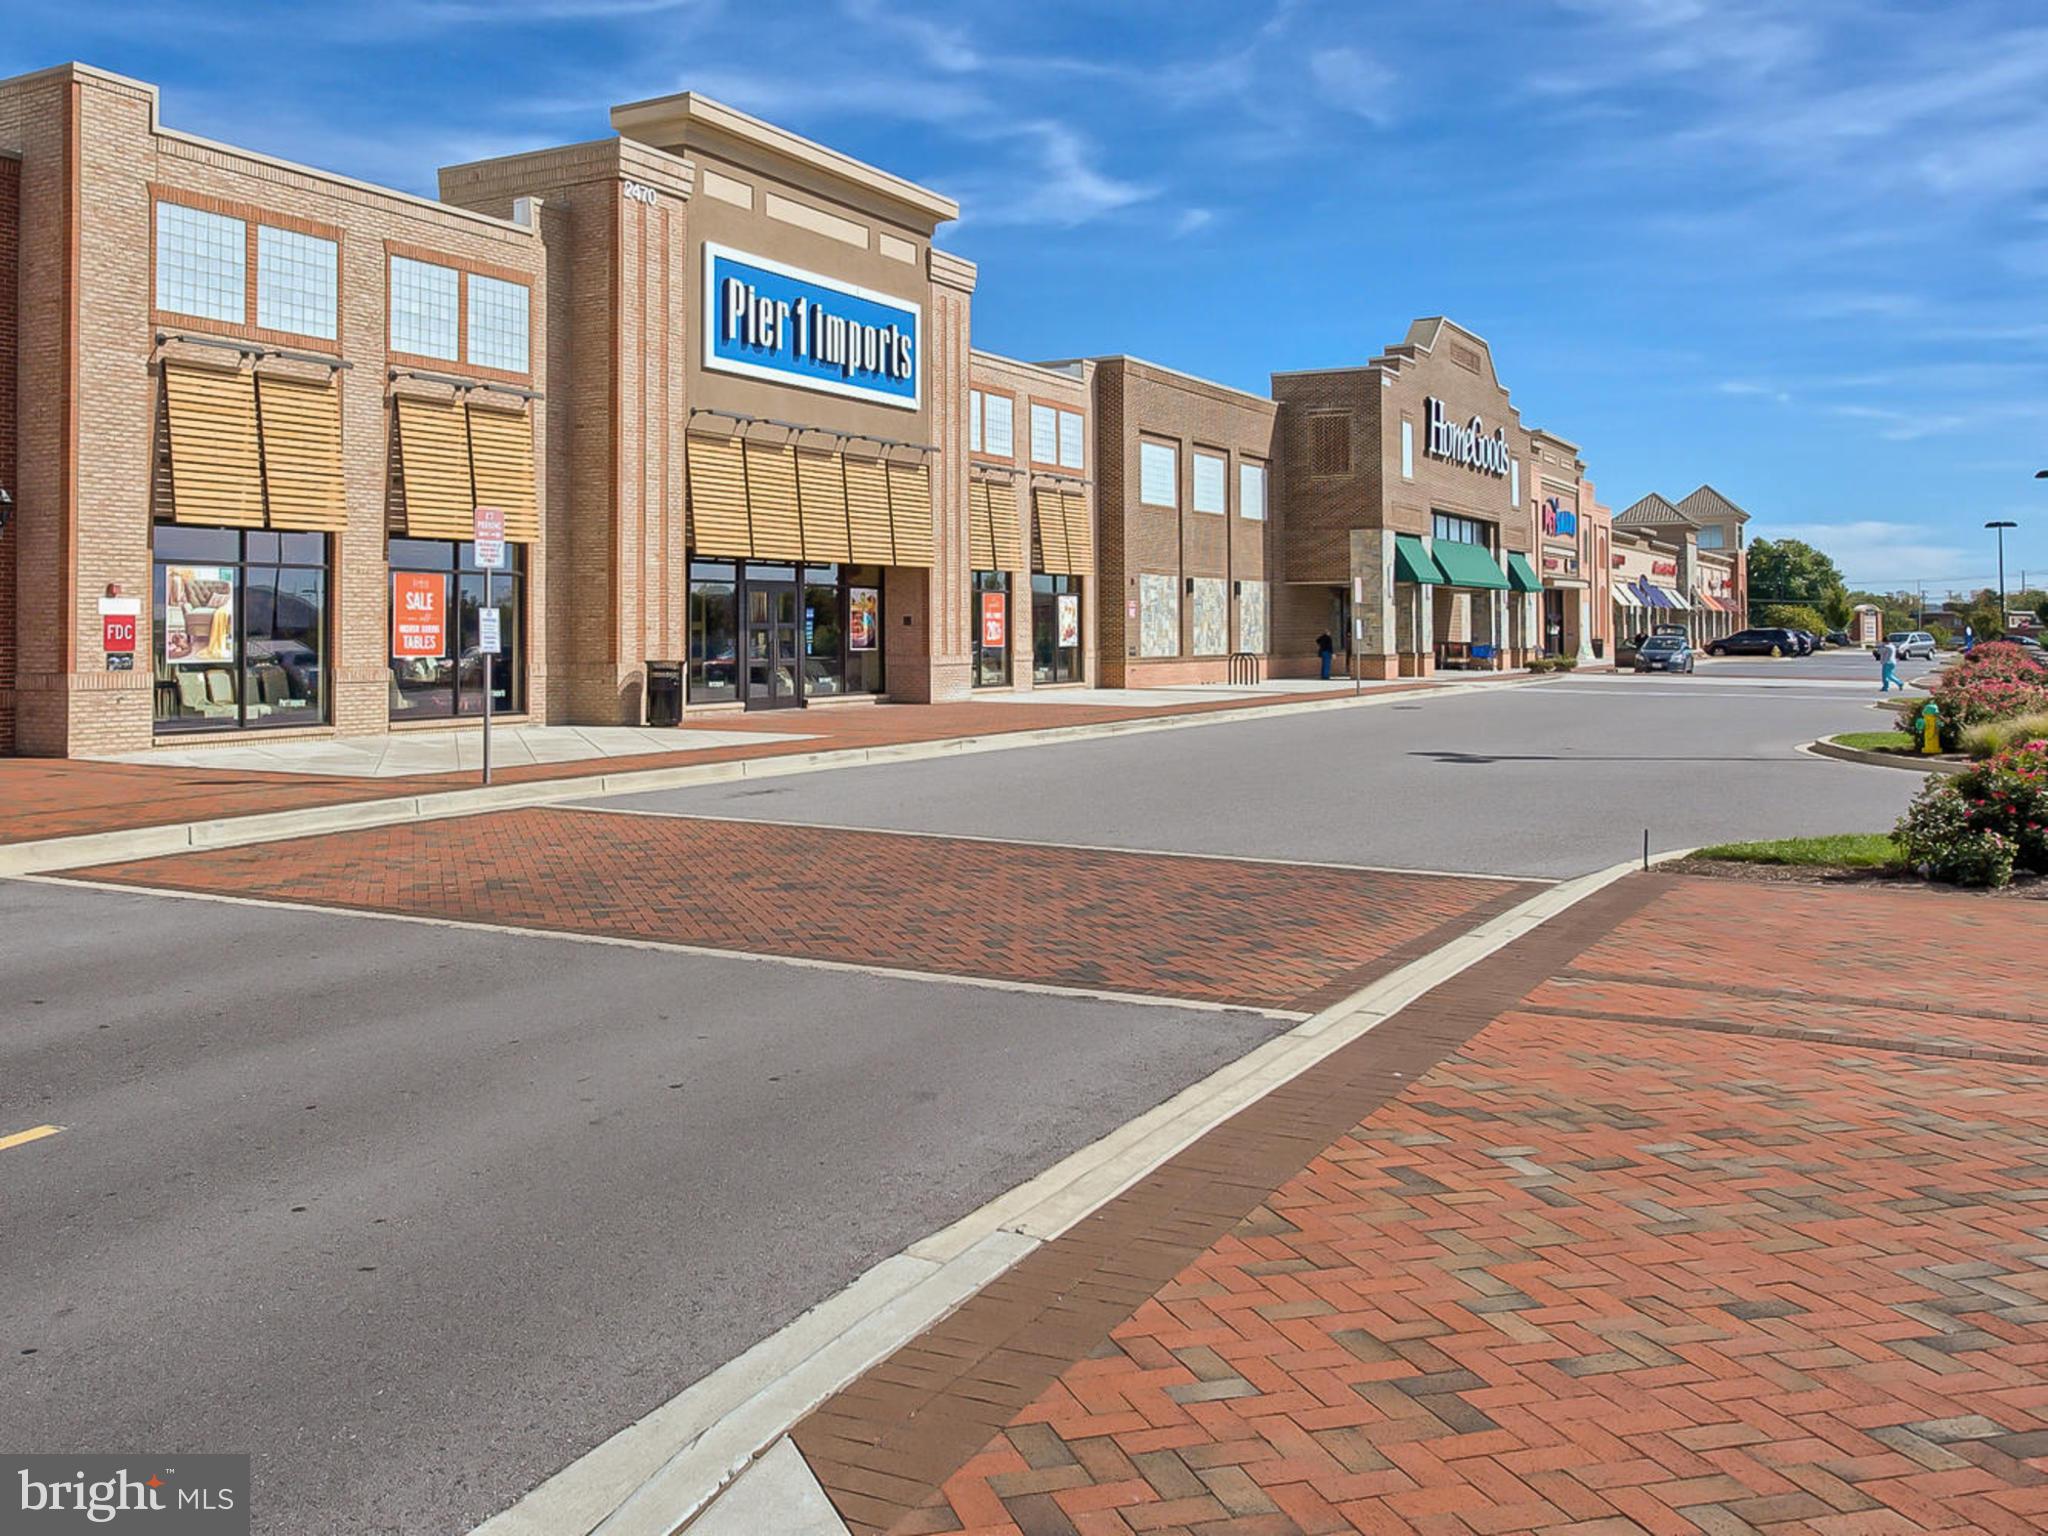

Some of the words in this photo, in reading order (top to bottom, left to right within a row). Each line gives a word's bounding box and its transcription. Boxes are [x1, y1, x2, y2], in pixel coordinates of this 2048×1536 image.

[624, 181, 656, 205] 2470
[728, 277, 789, 349] Pier
[797, 296, 808, 355] 1
[816, 304, 912, 379] imports
[1429, 396, 1509, 475] HomeGoods
[406, 592, 433, 610] SALE
[107, 624, 132, 640] FDC
[403, 635, 436, 649] TABLES
